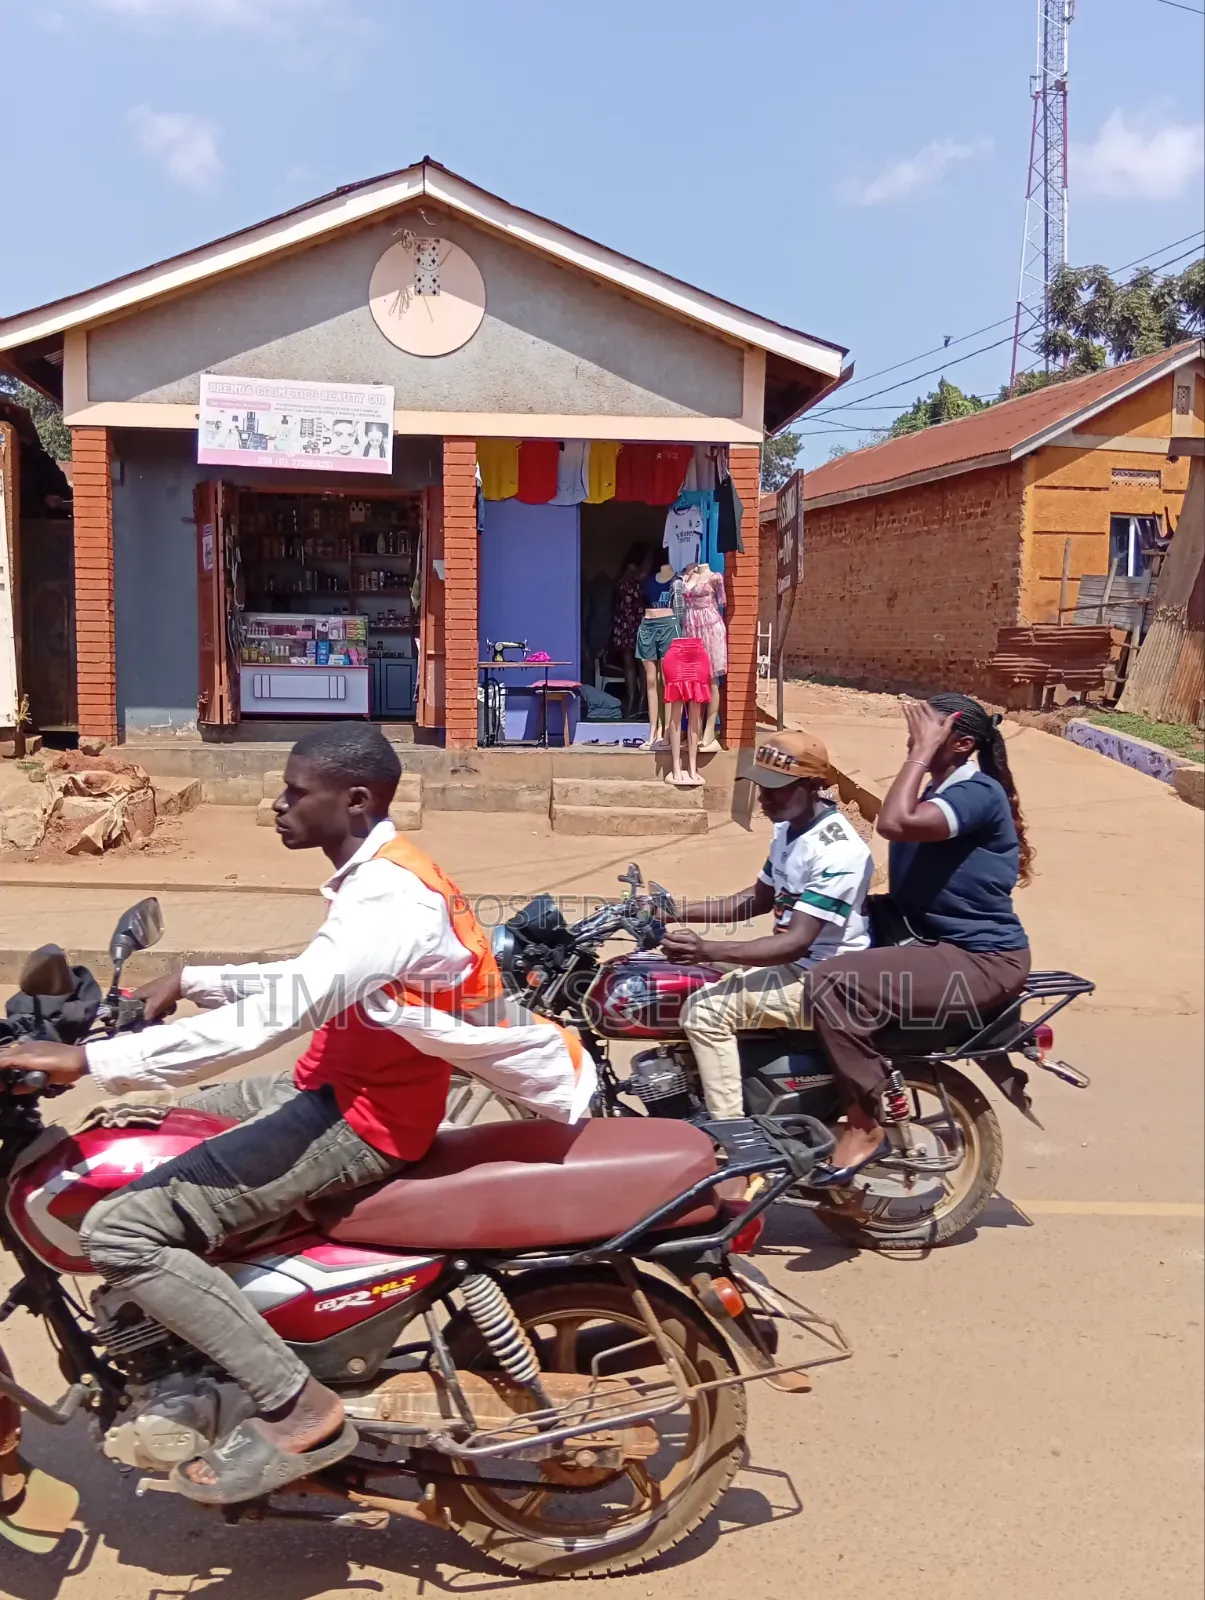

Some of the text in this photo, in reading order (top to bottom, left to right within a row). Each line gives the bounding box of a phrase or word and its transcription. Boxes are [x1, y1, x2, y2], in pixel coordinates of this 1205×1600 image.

[208, 382, 253, 396] BRENDA
[255, 386, 319, 401] COSMETICS
[320, 390, 365, 404] BEAUTY
[818, 821, 849, 847] 12
